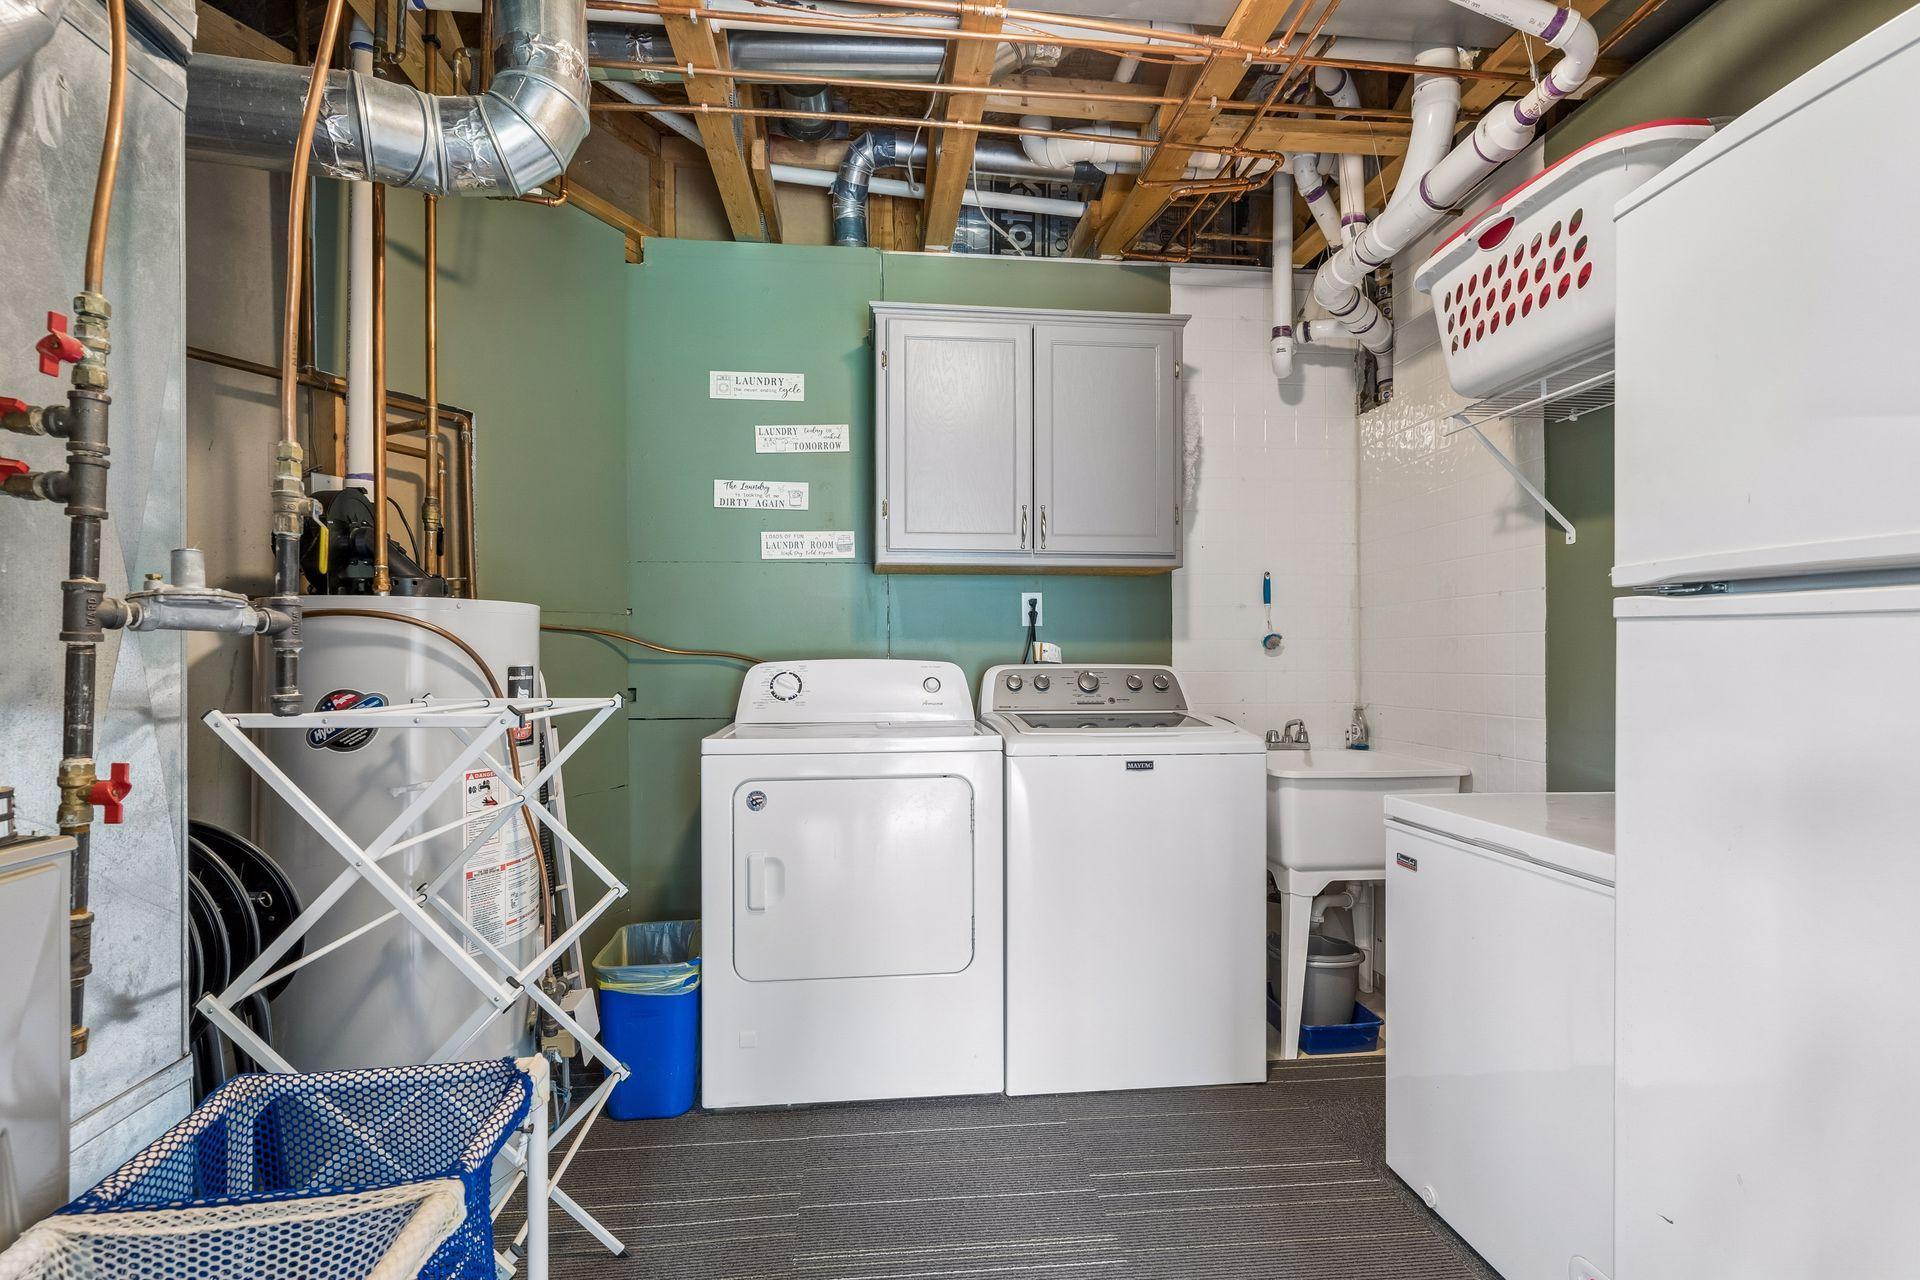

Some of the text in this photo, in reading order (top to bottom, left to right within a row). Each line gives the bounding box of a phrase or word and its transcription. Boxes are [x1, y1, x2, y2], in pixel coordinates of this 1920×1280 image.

[735, 376, 784, 386] LAUNDRY
[778, 384, 801, 399] cycle
[758, 427, 798, 436] LAUNDRY
[793, 441, 842, 451] TOMORROW
[723, 481, 770, 494] The Laundry
[719, 497, 785, 508] DIRTY AGAIN
[765, 541, 834, 550] LAUNDRY ROOM
[87, 597, 96, 626] WARD
